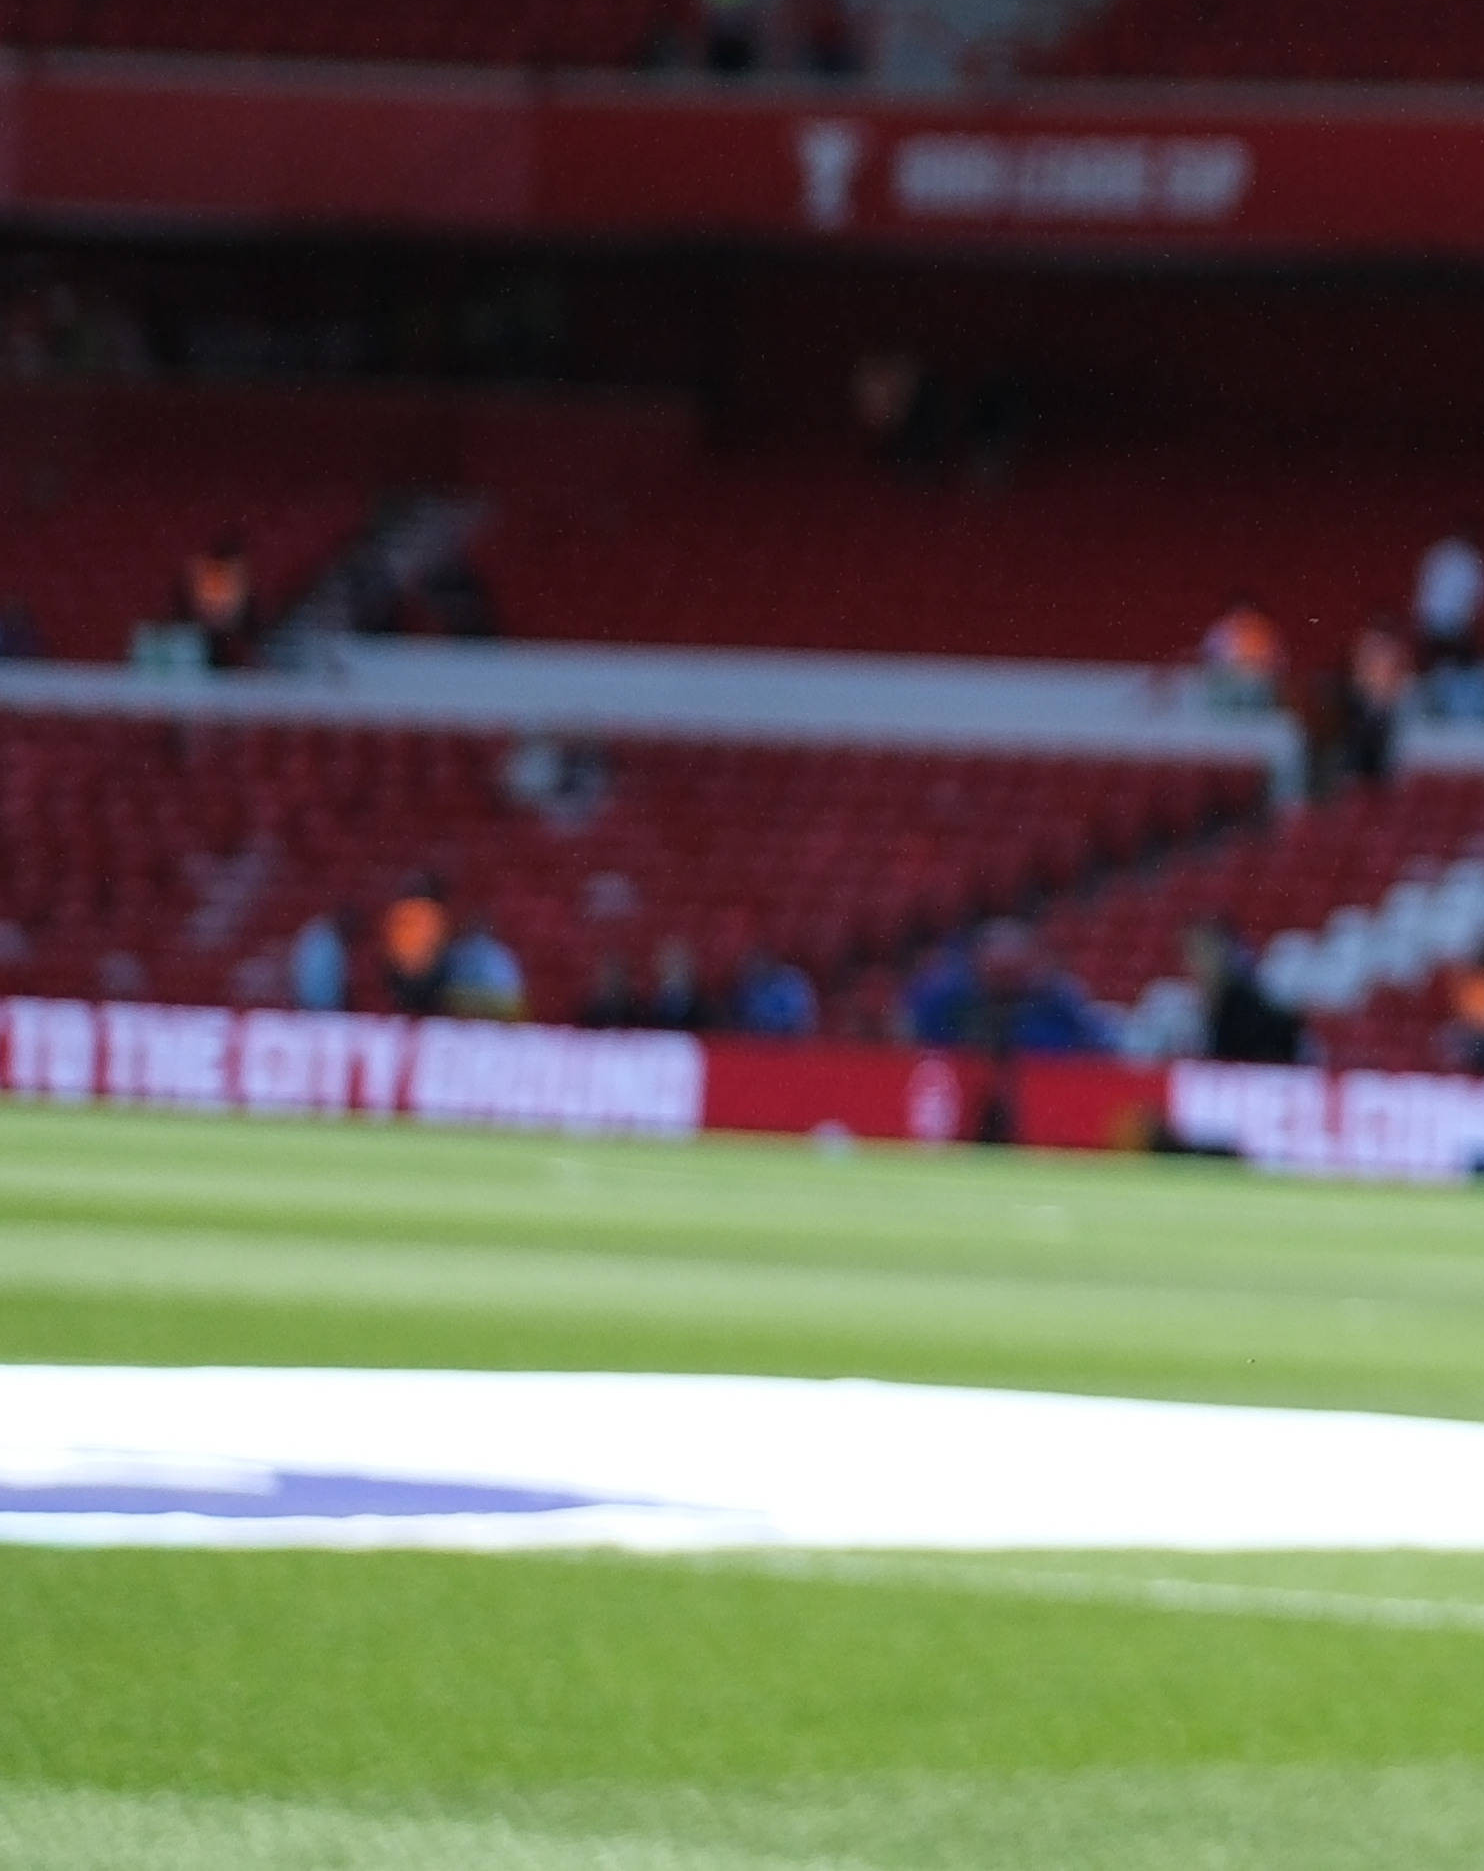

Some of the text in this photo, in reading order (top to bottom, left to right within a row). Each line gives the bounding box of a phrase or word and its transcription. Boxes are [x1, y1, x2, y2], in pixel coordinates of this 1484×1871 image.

[8, 999, 95, 1095] TO
[103, 1003, 233, 1099] THE
[238, 1010, 408, 1109] CITY
